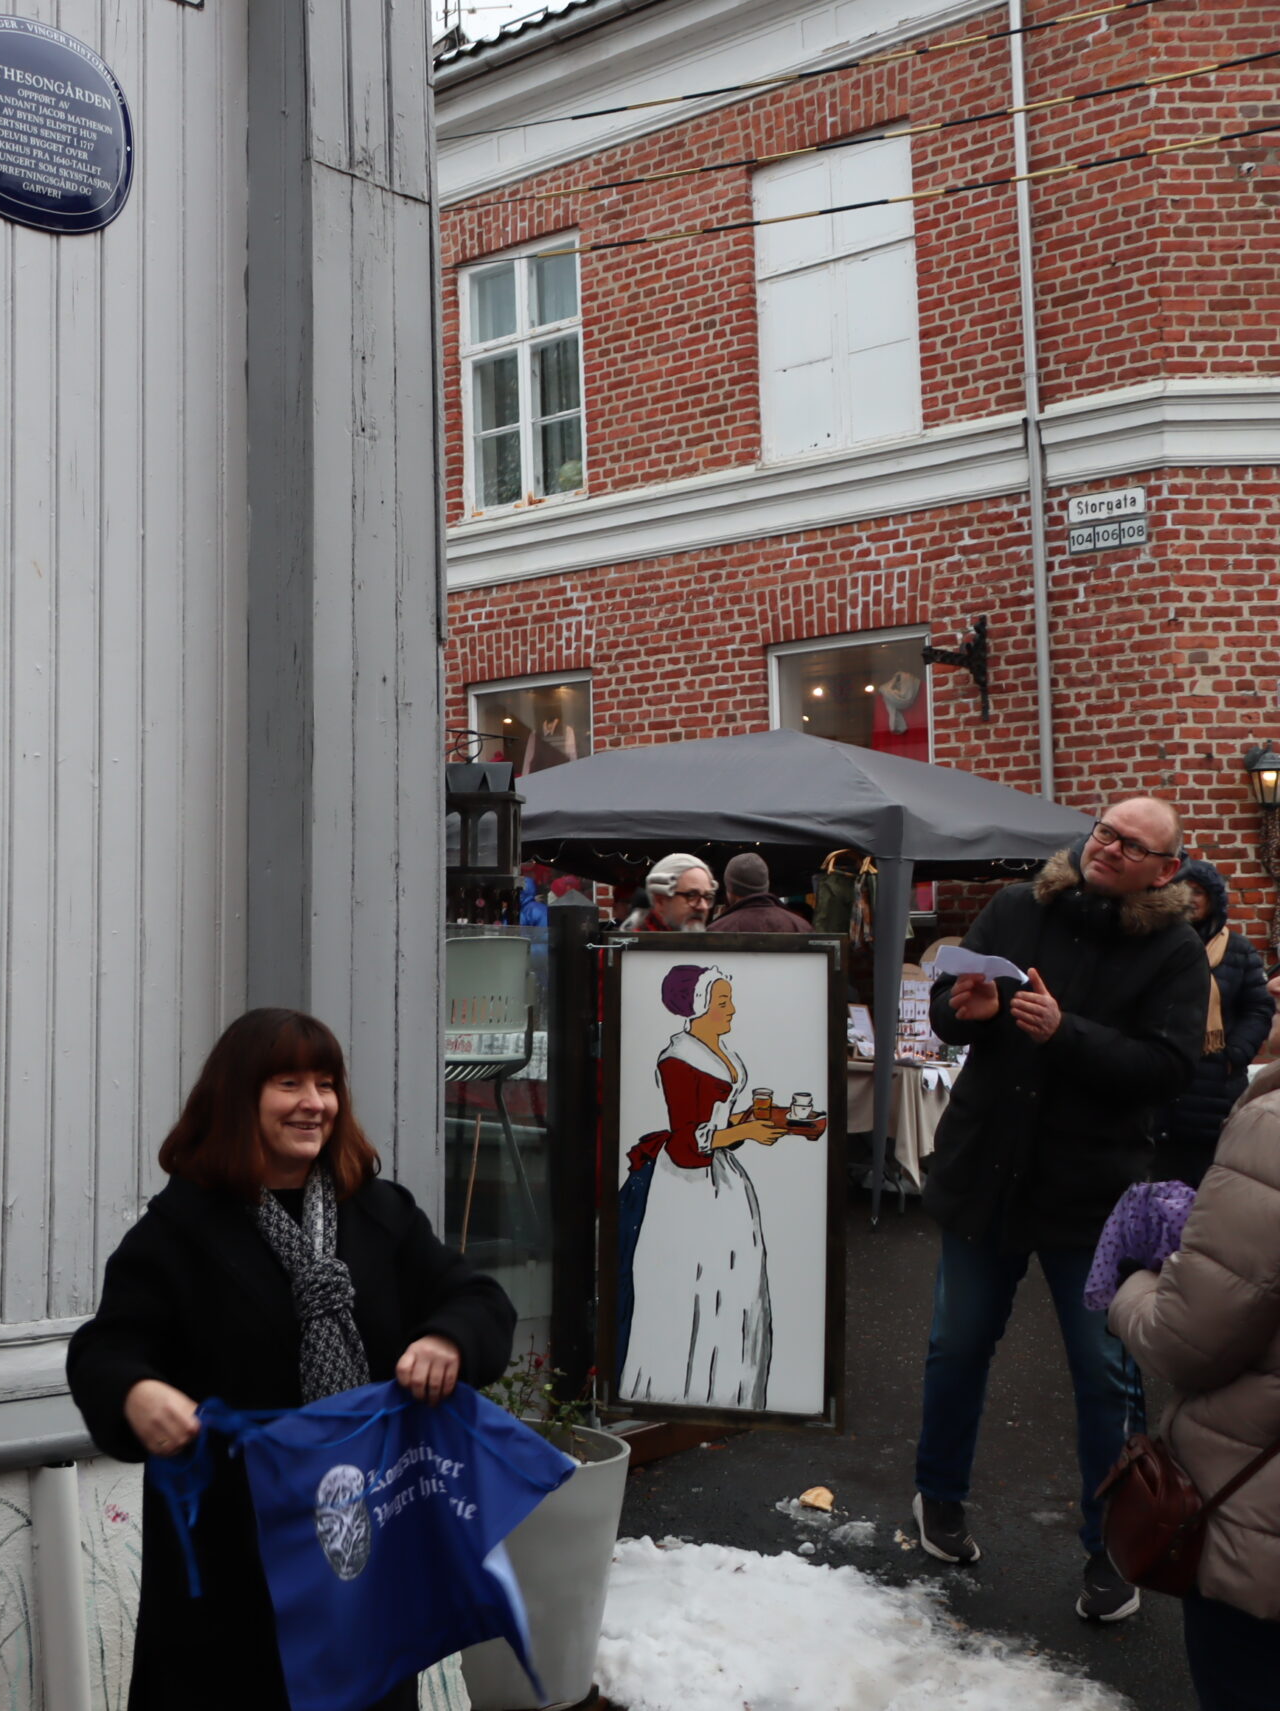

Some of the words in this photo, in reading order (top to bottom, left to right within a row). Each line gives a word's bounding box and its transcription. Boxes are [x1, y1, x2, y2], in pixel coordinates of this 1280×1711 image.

[26, 23, 66, 44] VINGER
[17, 88, 56, 106] OPPFØRT
[58, 99, 70, 110] AV
[2, 107, 15, 116] AV
[16, 110, 44, 125] BYENS
[46, 118, 78, 134] ELDSTE
[80, 128, 97, 141] HUS
[39, 104, 65, 120] JACOB
[67, 113, 113, 135] MATHESON
[30, 137, 64, 153] BYGGET
[65, 147, 88, 160] OVER
[40, 128, 72, 144] SENEST
[80, 140, 95, 151] 1717
[32, 148, 50, 161] FRA
[53, 154, 102, 175] 1640-TALLET
[39, 162, 57, 174] SOM
[58, 167, 113, 192] SKYSSTASJON,
[22, 181, 62, 199] GARVERI
[79, 185, 93, 196] OG
[1076, 494, 1137, 515] Storgata
[1071, 532, 1093, 546] 104
[1096, 528, 1119, 542] 106
[1121, 525, 1145, 539] 108
